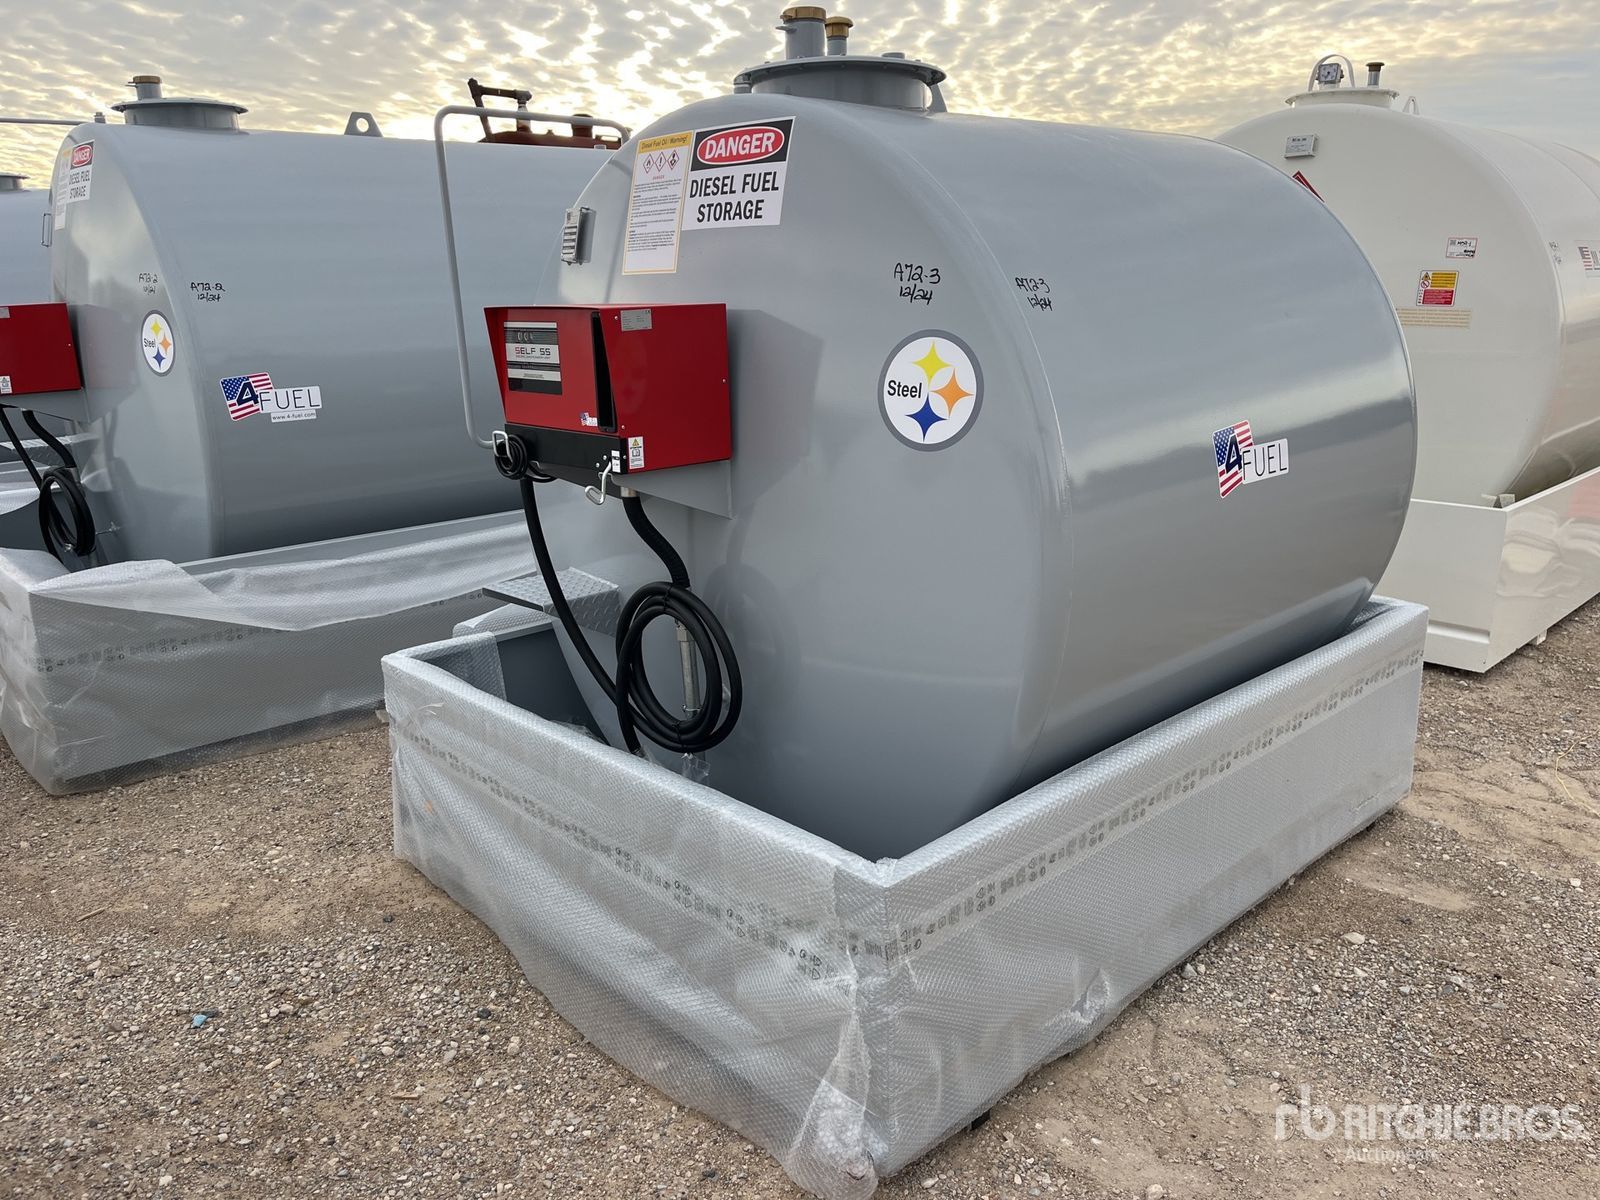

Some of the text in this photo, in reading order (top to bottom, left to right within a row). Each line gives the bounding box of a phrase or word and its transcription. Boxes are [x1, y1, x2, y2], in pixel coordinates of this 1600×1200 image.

[705, 132, 776, 160] DANGER
[69, 170, 91, 185] DIESEL FUEL
[690, 171, 779, 198] DIESEL FUEL
[69, 185, 87, 199] STORAGE
[697, 199, 764, 223] STORAGE
[893, 262, 941, 284] A72-3
[899, 283, 933, 305] 12/24
[143, 337, 156, 348] Steel
[514, 346, 536, 355] SELF
[887, 379, 922, 398] Steel
